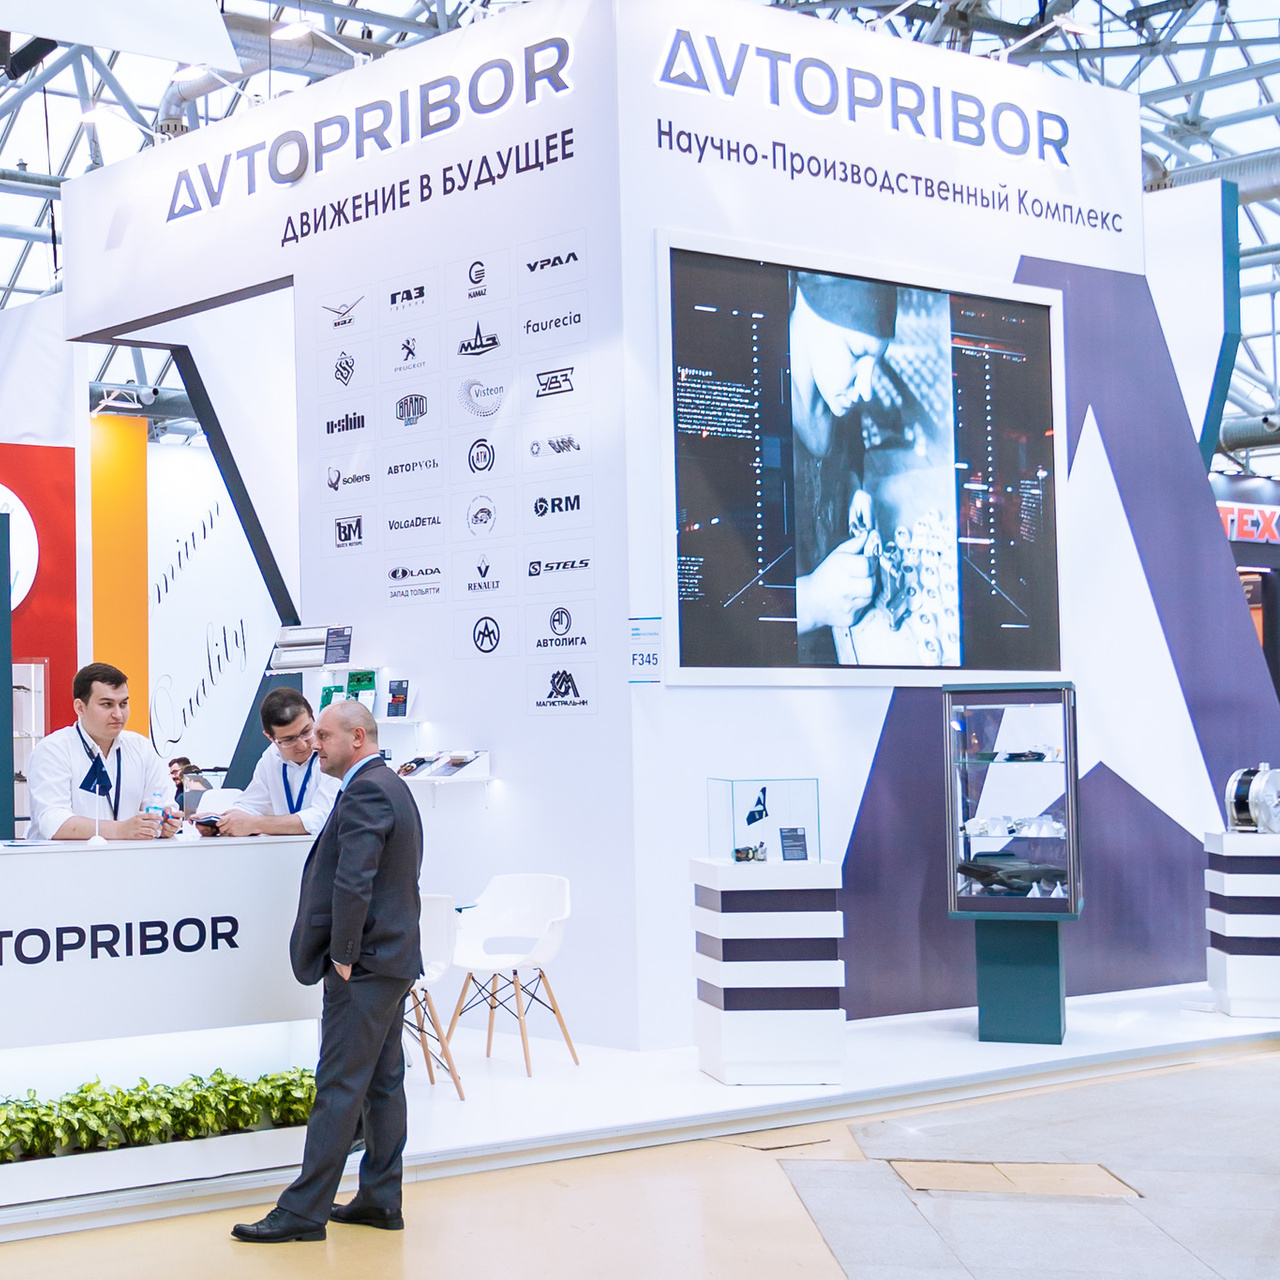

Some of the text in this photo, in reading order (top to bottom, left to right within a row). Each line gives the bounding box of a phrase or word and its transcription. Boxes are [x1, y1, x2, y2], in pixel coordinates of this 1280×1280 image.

[658, 28, 1071, 168] AVTOPRIBOR
[166, 37, 571, 223] AVTOPRIBOR
[656, 119, 1123, 233] Научно-Производственный Комплекс
[280, 127, 576, 248] ДВИЖЕНИЕ В БУДУЩЕЕ
[526, 252, 579, 272] УРАЛ
[390, 285, 425, 305] ГАЗ
[525, 311, 581, 334] faurecia
[394, 361, 426, 372] PEUGEOT
[474, 385, 504, 398] Visteon
[387, 459, 439, 475] АВТОРУСЬ
[342, 473, 371, 485] sollers
[551, 494, 581, 513] RM
[148, 500, 220, 618] mium
[543, 559, 591, 571] STELS
[410, 567, 442, 577] LADA
[467, 580, 500, 591] RENAULT
[535, 636, 587, 648] АВТОЛИГА
[632, 653, 659, 666] F345
[149, 619, 247, 758] Quality
